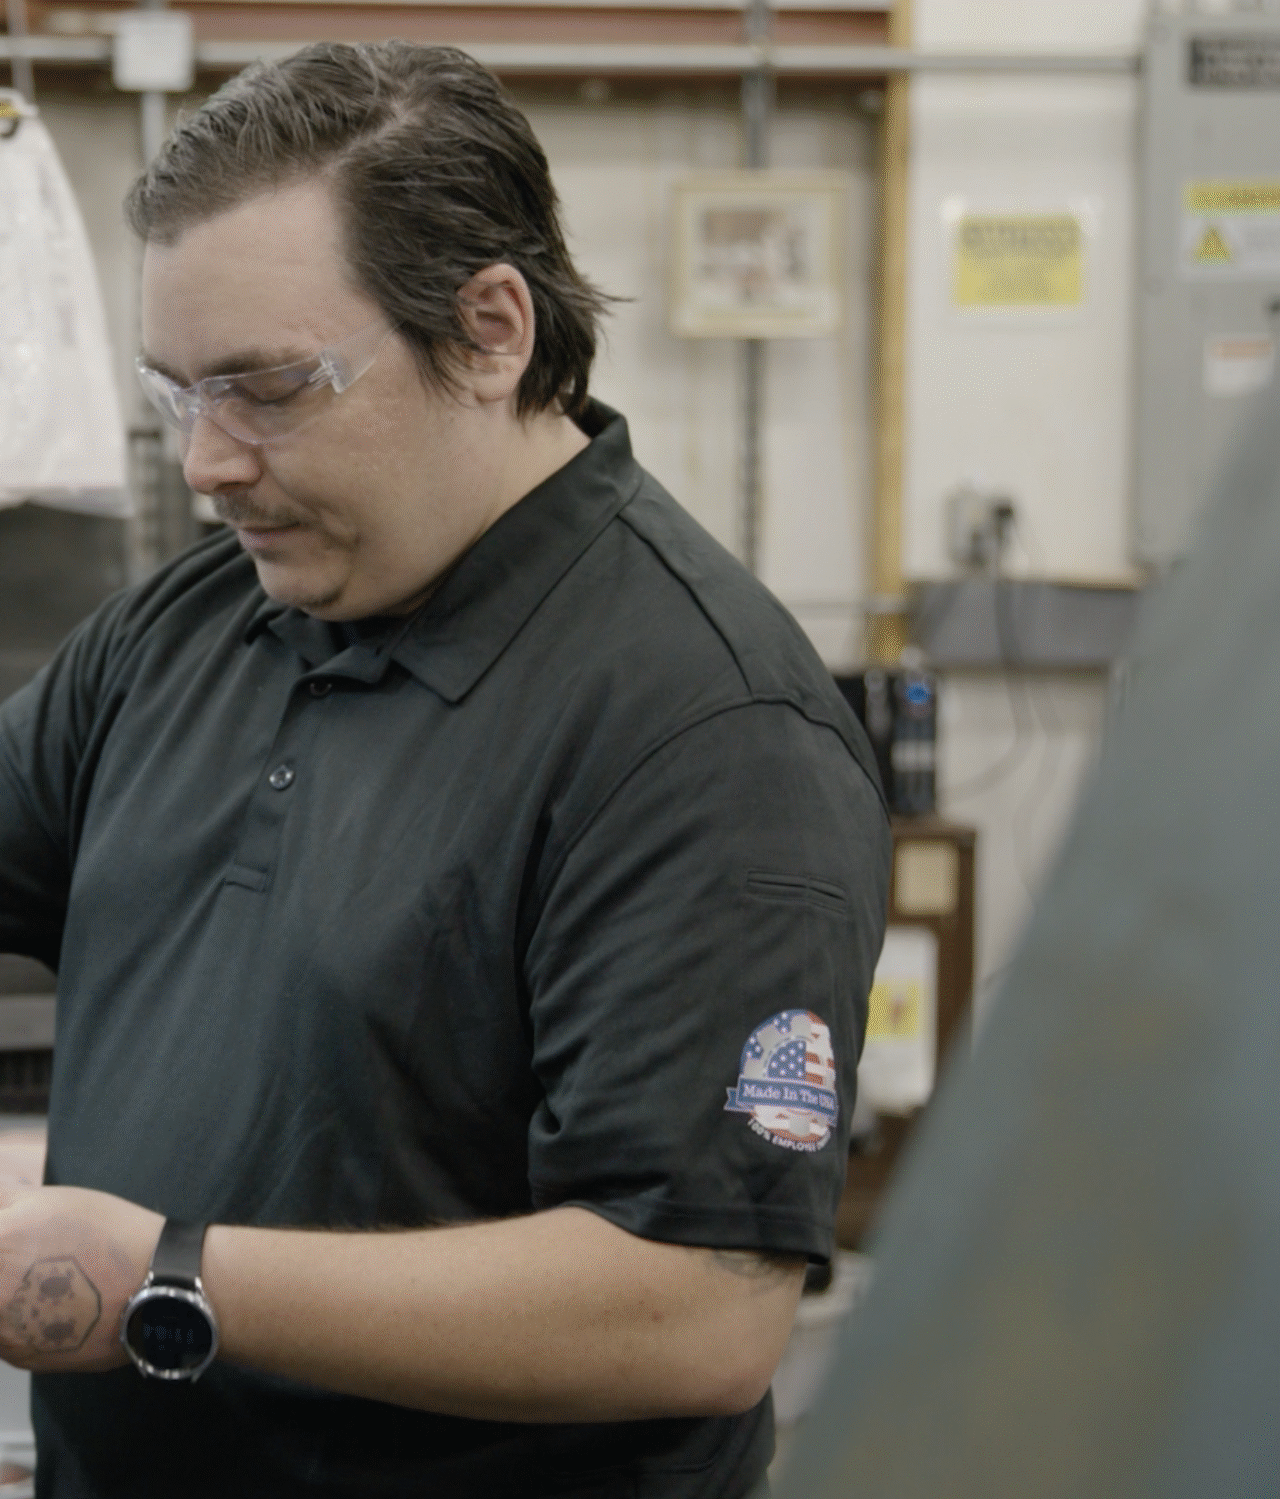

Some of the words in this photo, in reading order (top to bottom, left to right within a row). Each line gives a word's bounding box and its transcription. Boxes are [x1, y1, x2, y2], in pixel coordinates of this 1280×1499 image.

[743, 1085, 781, 1099] Made
[783, 1087, 798, 1101] In
[799, 1089, 818, 1105] The
